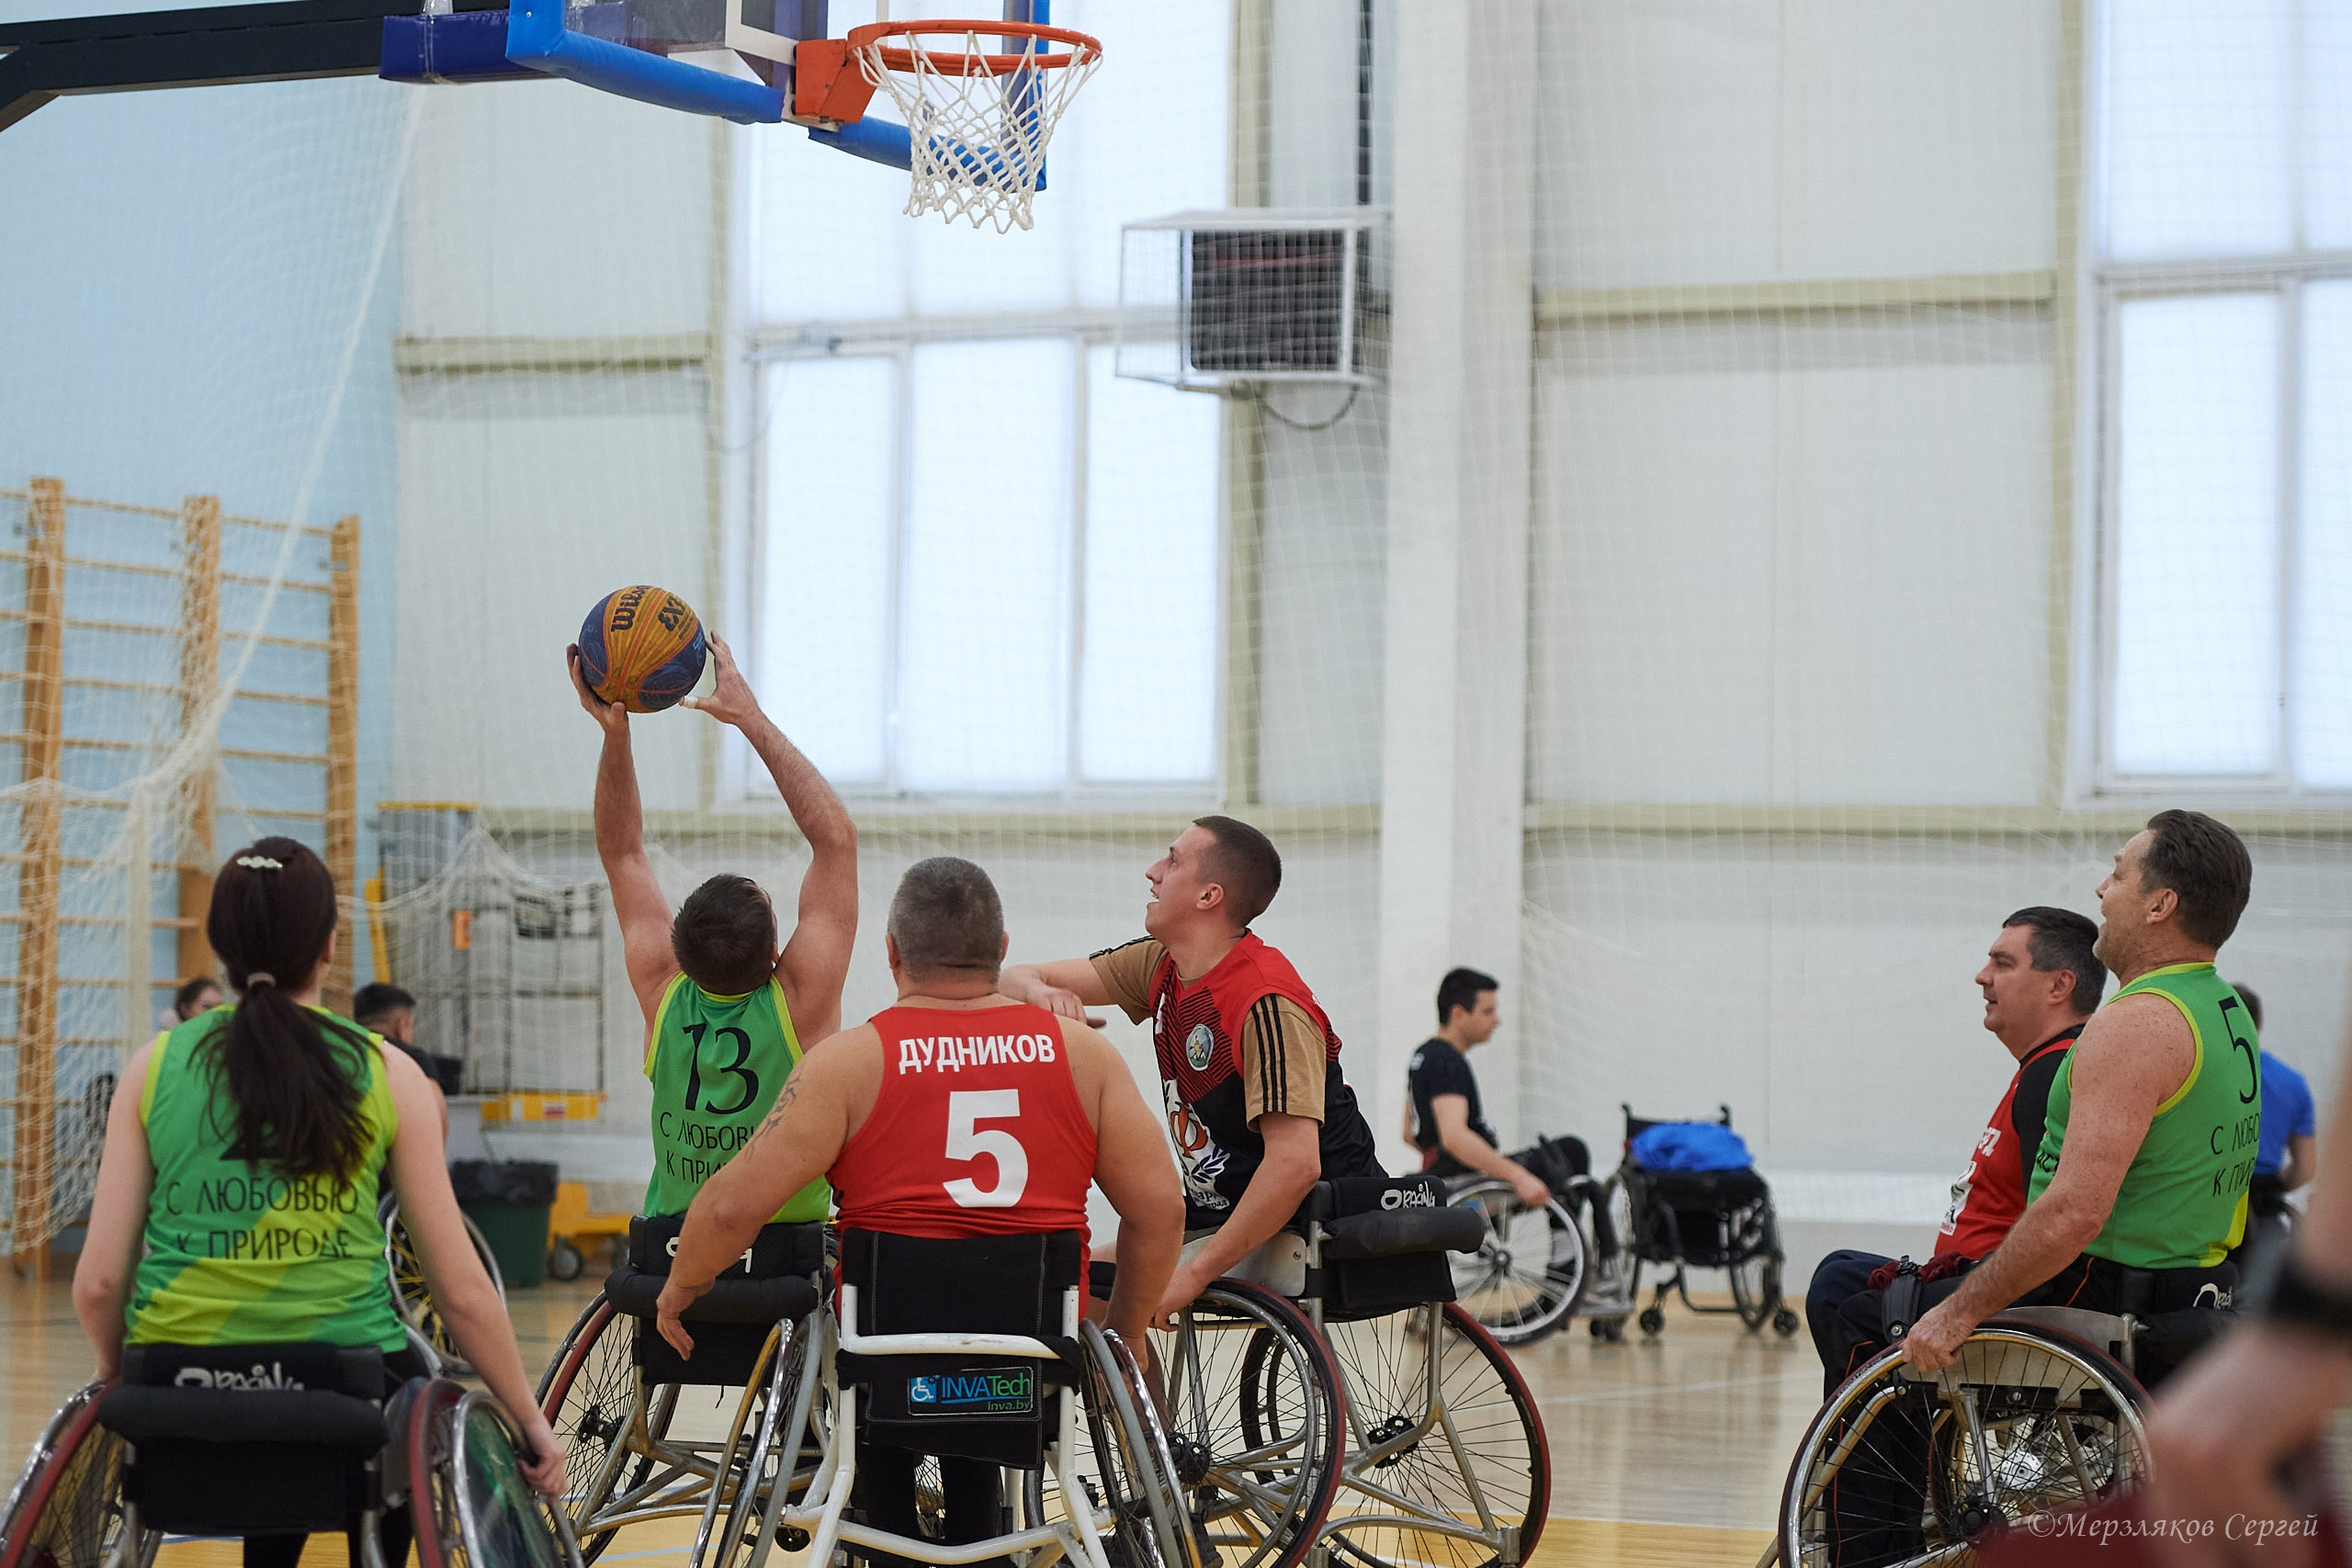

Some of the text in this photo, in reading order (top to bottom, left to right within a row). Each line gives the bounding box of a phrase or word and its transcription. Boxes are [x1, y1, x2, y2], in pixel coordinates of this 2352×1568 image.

[683, 1023, 759, 1114] 13
[899, 1034, 1056, 1075] ДУДНИКОВ
[2218, 995, 2257, 1104] 5
[660, 1111, 753, 1151] С ЛЮБОВ
[943, 1089, 1028, 1208] 5
[2211, 1111, 2262, 1156] С ЛЮБО
[666, 1150, 675, 1177] К
[166, 1176, 359, 1216] С ЛЮБОВЬЮ
[209, 1228, 353, 1259] ПРИРОДЕ
[942, 1372, 1030, 1397] INVATech
